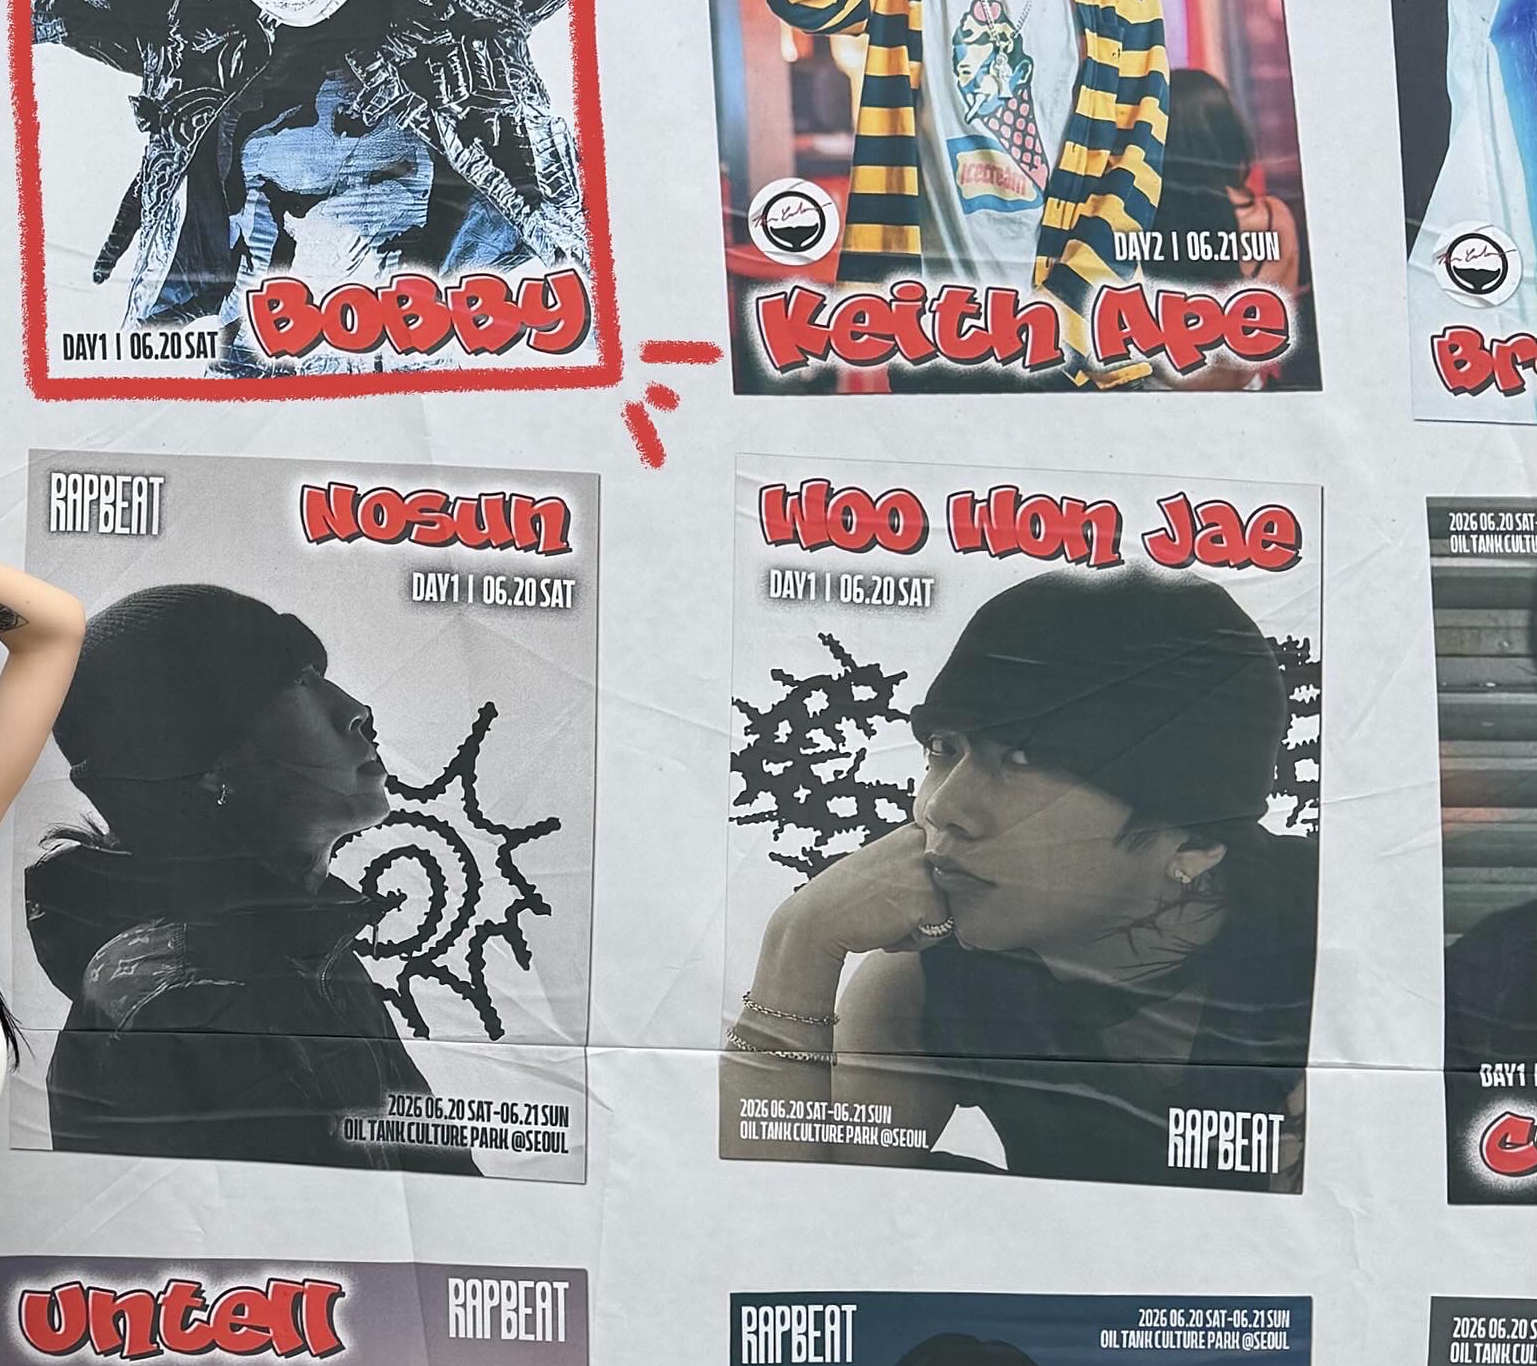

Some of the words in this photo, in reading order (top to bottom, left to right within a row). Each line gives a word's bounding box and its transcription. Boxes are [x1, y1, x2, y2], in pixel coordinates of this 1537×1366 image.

[1113, 231, 1165, 261] DAY2
[1186, 231, 1239, 261] 06.21
[1241, 231, 1281, 261] SUN
[63, 333, 107, 360] DAY1
[129, 332, 182, 360] 06.20
[185, 331, 218, 359] SAT
[1431, 324, 1537, 397] Br
[50, 472, 165, 535] RAPBEAT
[412, 572, 459, 603] DAY1
[483, 574, 536, 607] 06.20
[539, 578, 576, 609] SAT
[769, 569, 817, 601] DAY1
[839, 572, 895, 605] 06.20
[897, 576, 935, 607] SAT
[1167, 1107, 1284, 1173] RAPBEAT
[448, 1278, 569, 1342] RAPBEAT
[741, 1304, 857, 1364] RAPBEAT
